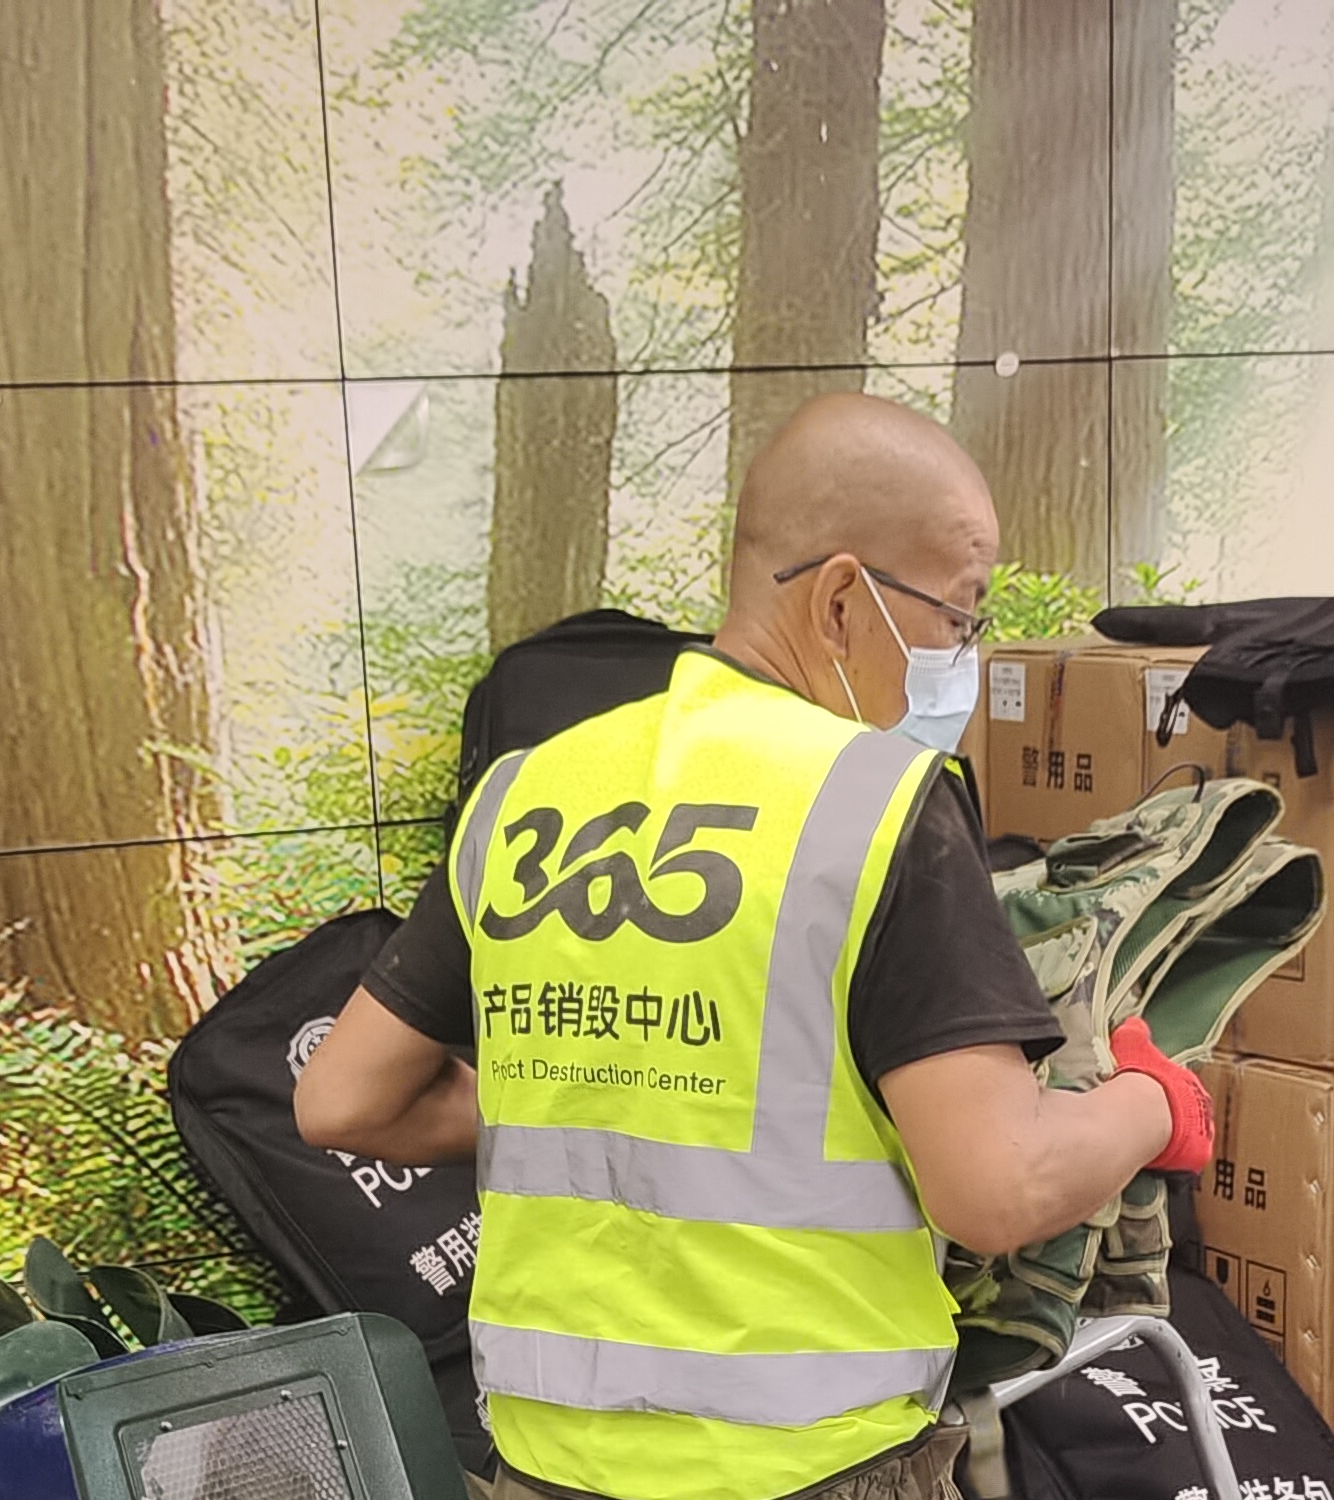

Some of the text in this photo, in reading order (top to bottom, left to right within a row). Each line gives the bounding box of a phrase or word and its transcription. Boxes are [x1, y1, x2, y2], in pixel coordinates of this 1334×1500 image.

[1022, 746, 1094, 793] 警用品
[479, 801, 760, 943] 365
[482, 982, 722, 1046] 产品销毁中心
[532, 1059, 644, 1087] Destruction
[647, 1066, 727, 1096] Center
[351, 1160, 434, 1209] PO
[1196, 1156, 1267, 1212] 用品
[1123, 1396, 1278, 1444] POCE
